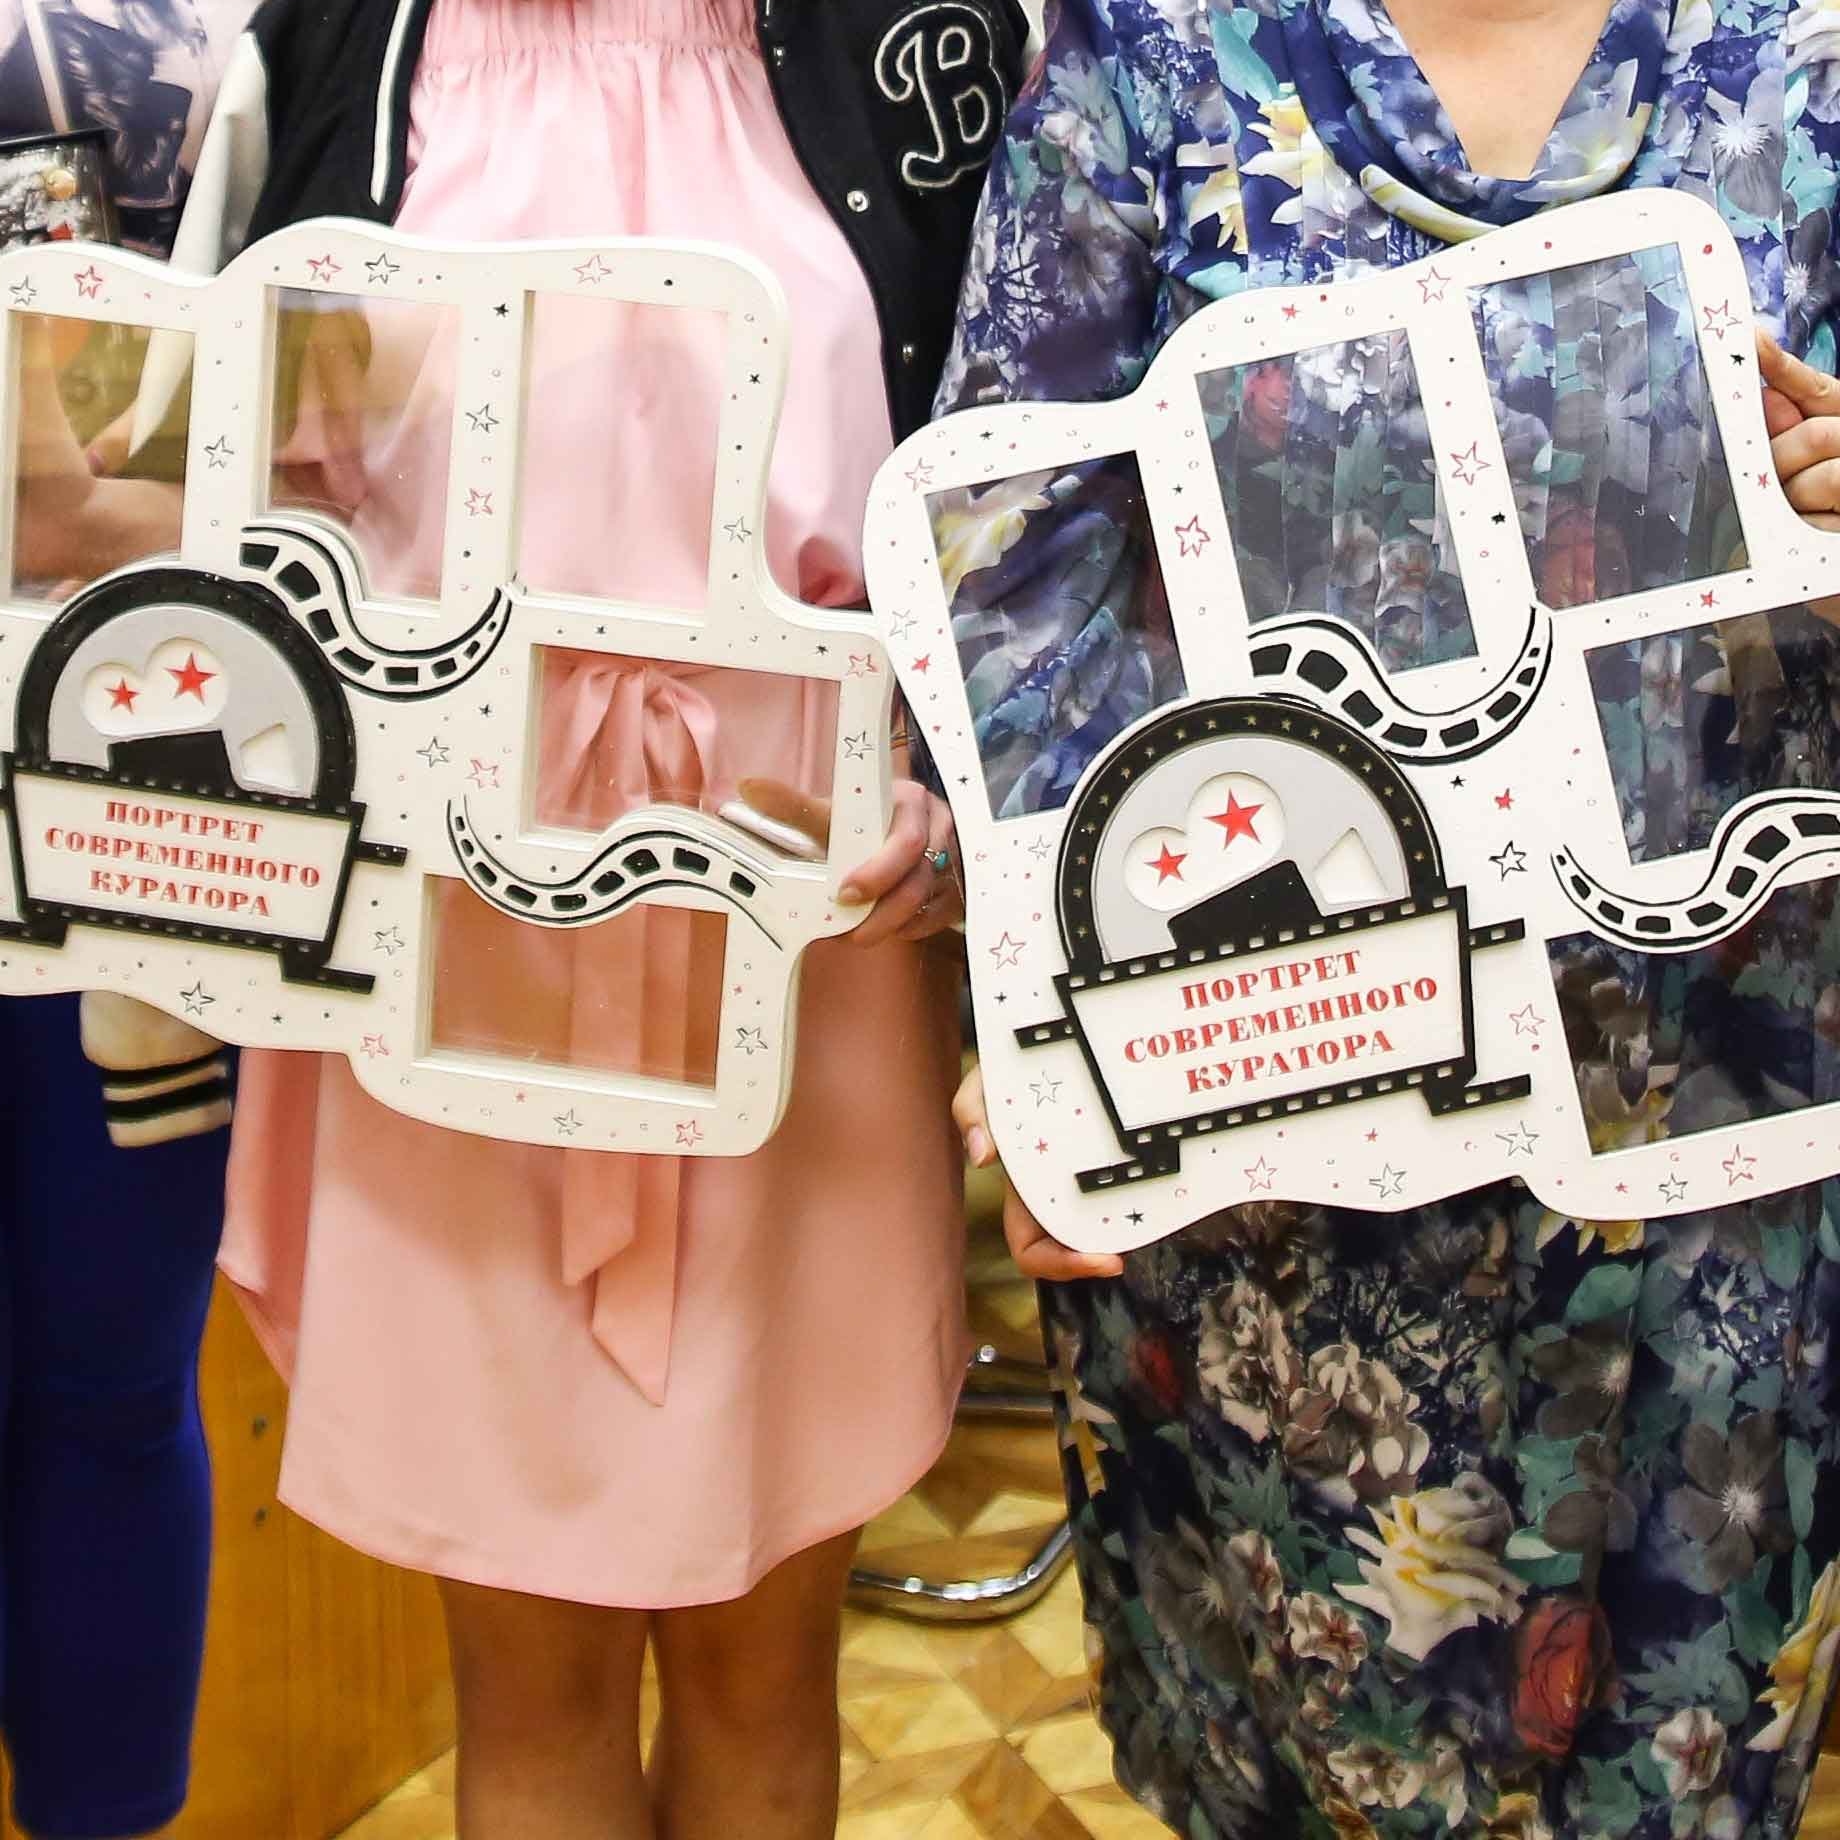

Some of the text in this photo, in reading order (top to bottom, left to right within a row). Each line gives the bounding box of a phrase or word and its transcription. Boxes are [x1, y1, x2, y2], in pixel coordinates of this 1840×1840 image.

[874, 2, 1007, 188] B
[106, 800, 265, 844] ПОРТРЕТ
[44, 826, 321, 888] СОВРЕМЕННОГО
[89, 869, 271, 918] КУРАТОРА
[1180, 949, 1362, 1010] ПОРТРЕТ
[1124, 976, 1439, 1064] СОВРЕМЕННОГО
[1185, 1028, 1395, 1094] КУРАТОРА
